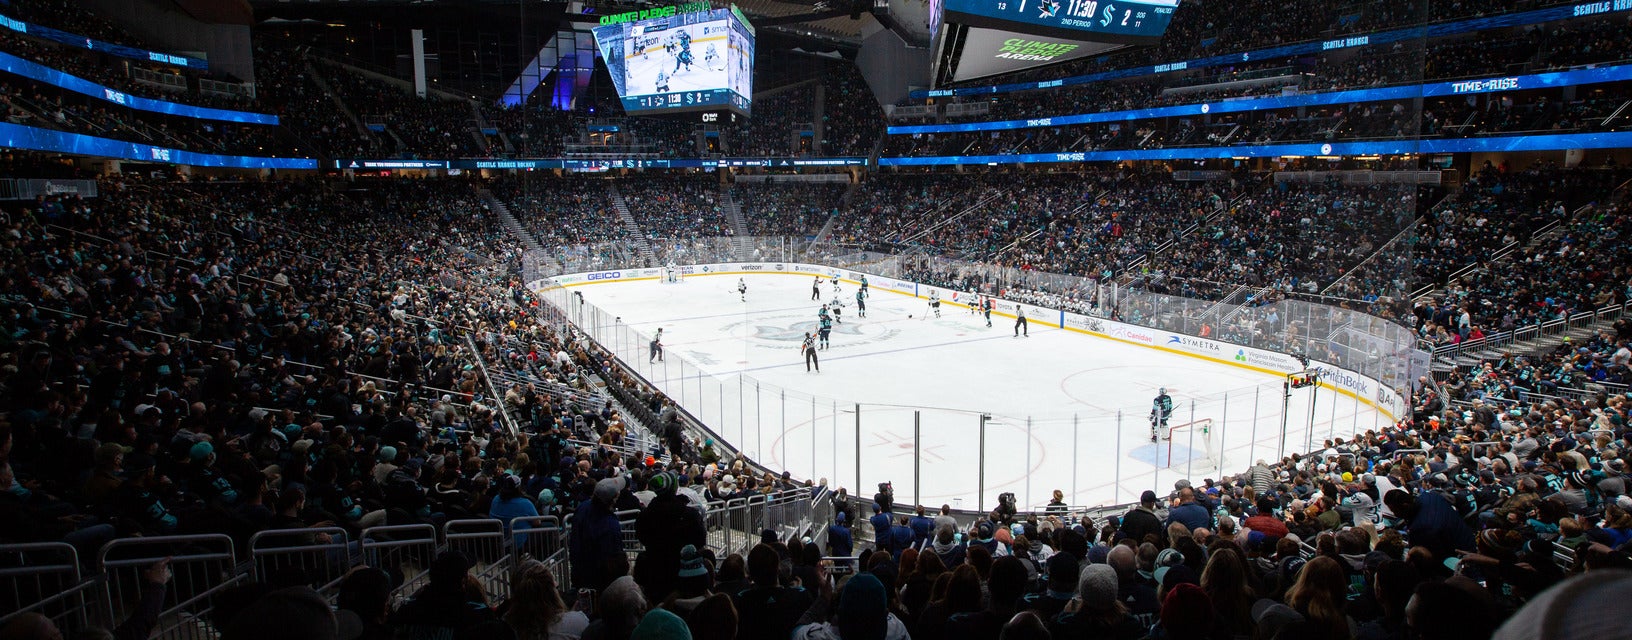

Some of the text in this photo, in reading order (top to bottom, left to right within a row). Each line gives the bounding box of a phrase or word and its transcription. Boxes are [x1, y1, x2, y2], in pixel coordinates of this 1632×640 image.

[600, 1, 712, 26] CLIMATE PLEDGE ARENA
[1067, 0, 1097, 18] 11:30
[1573, 1, 1610, 17] SEATTLE
[1073, 20, 1091, 28] PERIOD
[1121, 9, 1132, 26] 2
[1004, 38, 1078, 50] CLIMATE
[995, 52, 1055, 61] ARENA
[999, 45, 1069, 57] PLEDGE
[1452, 81, 1482, 93] TIME
[1489, 77, 1519, 90] RISE
[696, 93, 701, 103] 2
[588, 271, 621, 281] GEICO
[1127, 331, 1152, 342] Canidae
[1182, 337, 1220, 351] SYMETRA
[1323, 370, 1368, 394] PitchBook
